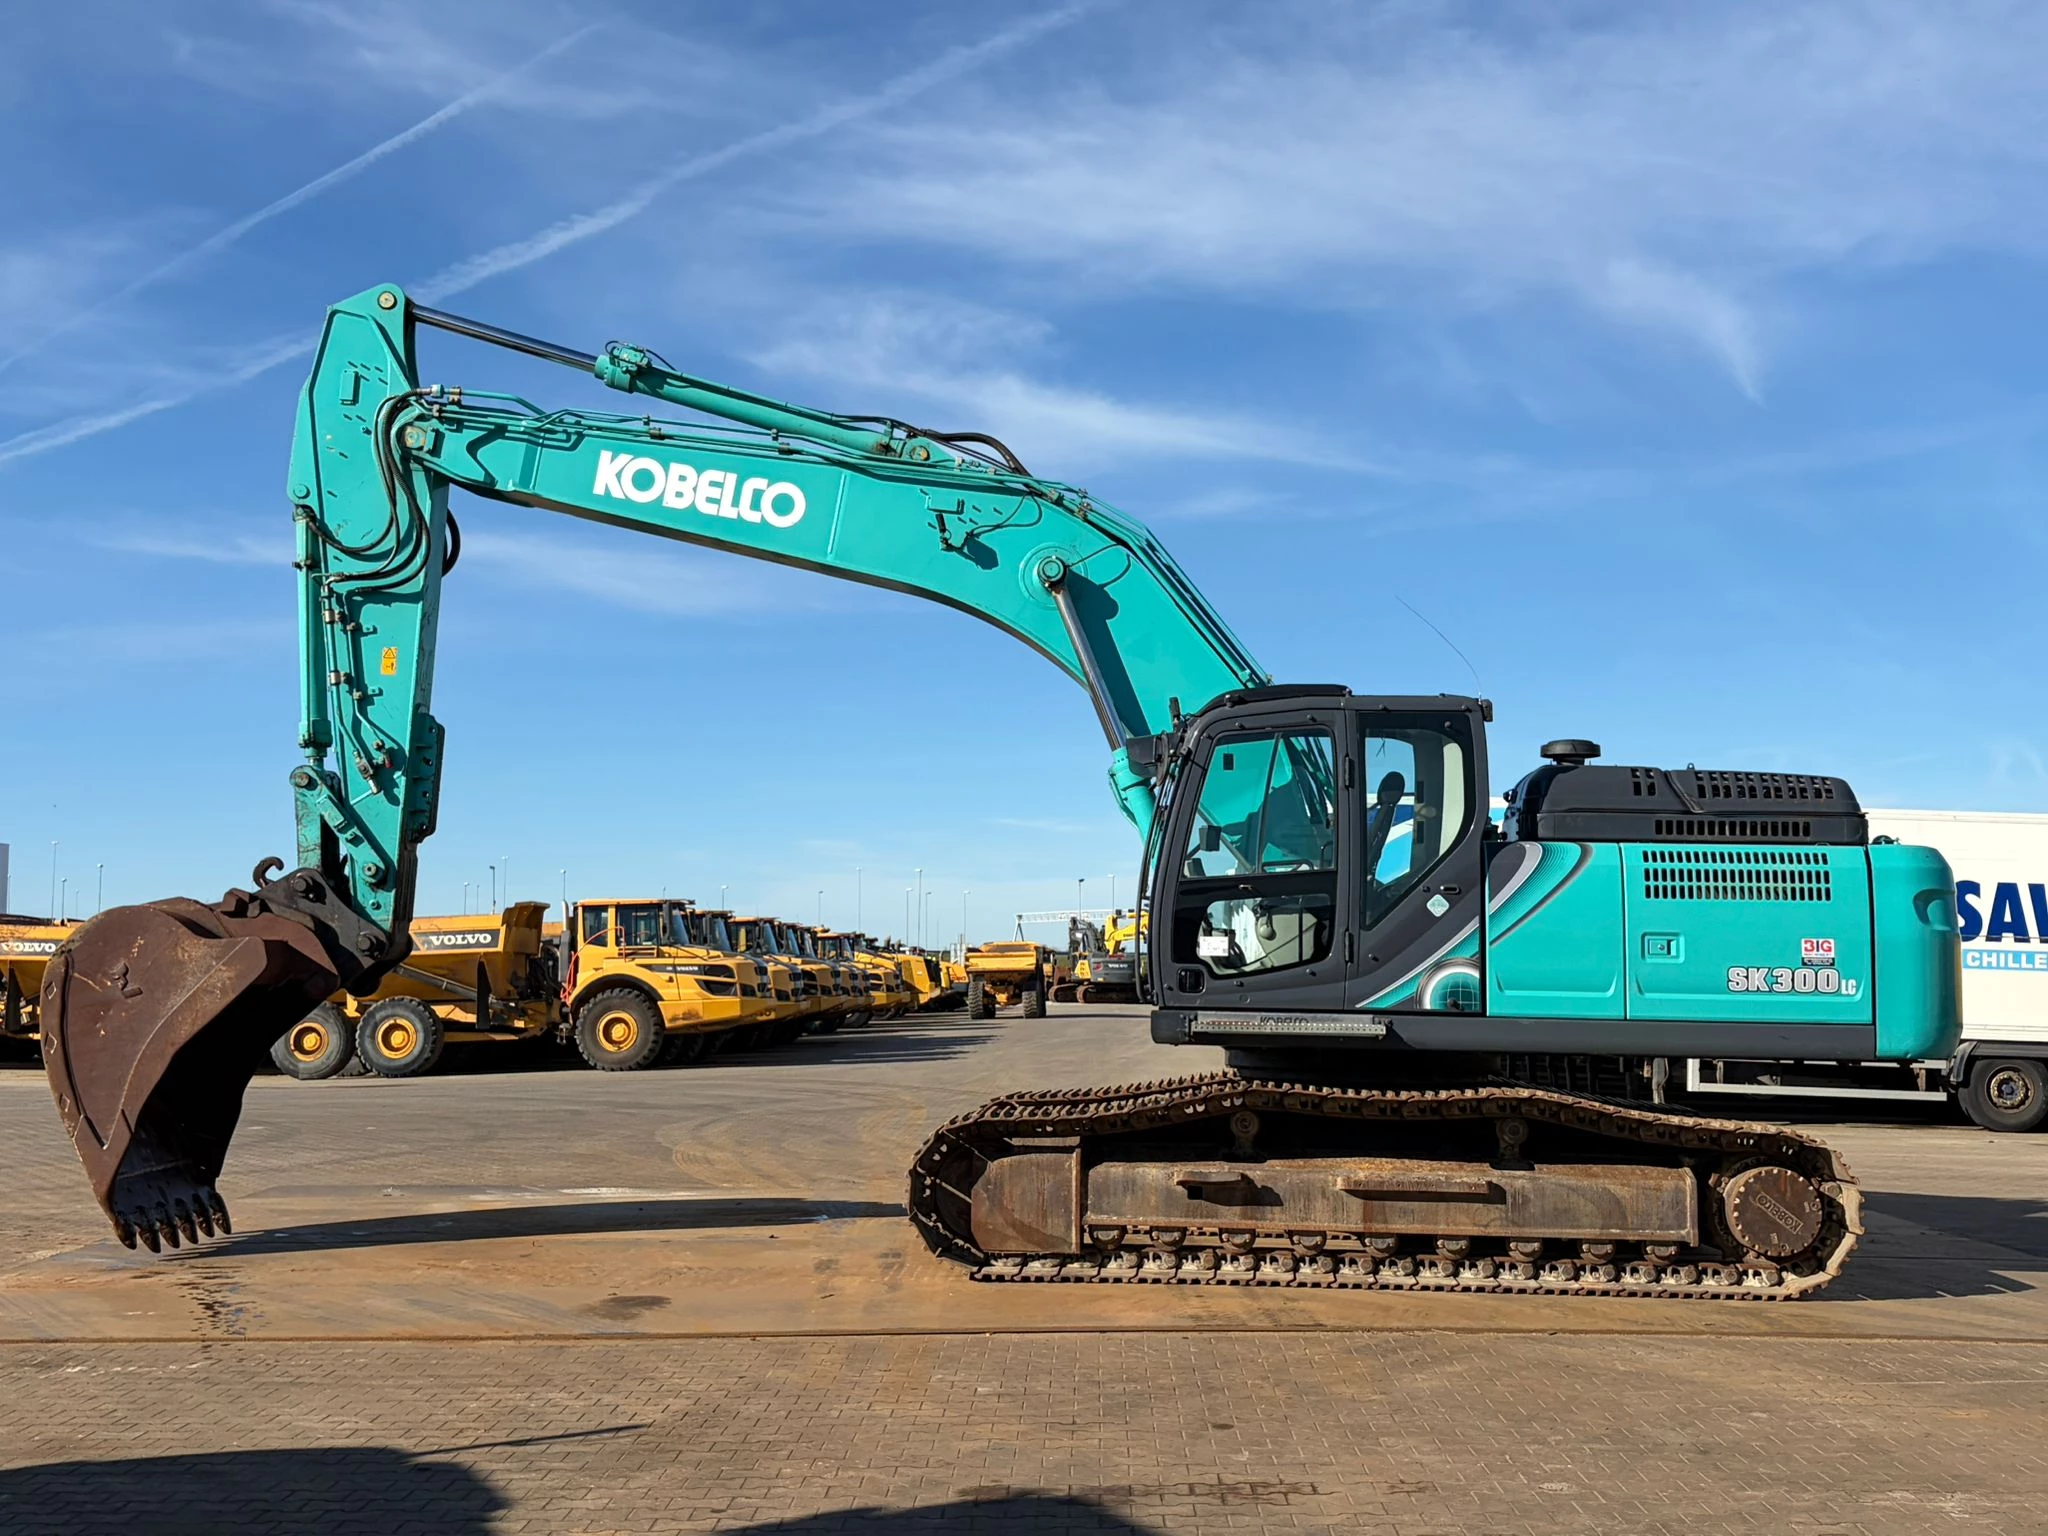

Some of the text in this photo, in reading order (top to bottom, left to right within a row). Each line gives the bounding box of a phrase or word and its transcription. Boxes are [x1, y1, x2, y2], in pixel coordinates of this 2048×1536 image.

[592, 449, 807, 528] KOBELCO
[1, 941, 57, 953] VOLVO
[429, 933, 492, 946] VOLVO
[1757, 1194, 1801, 1232] KOBELCO
